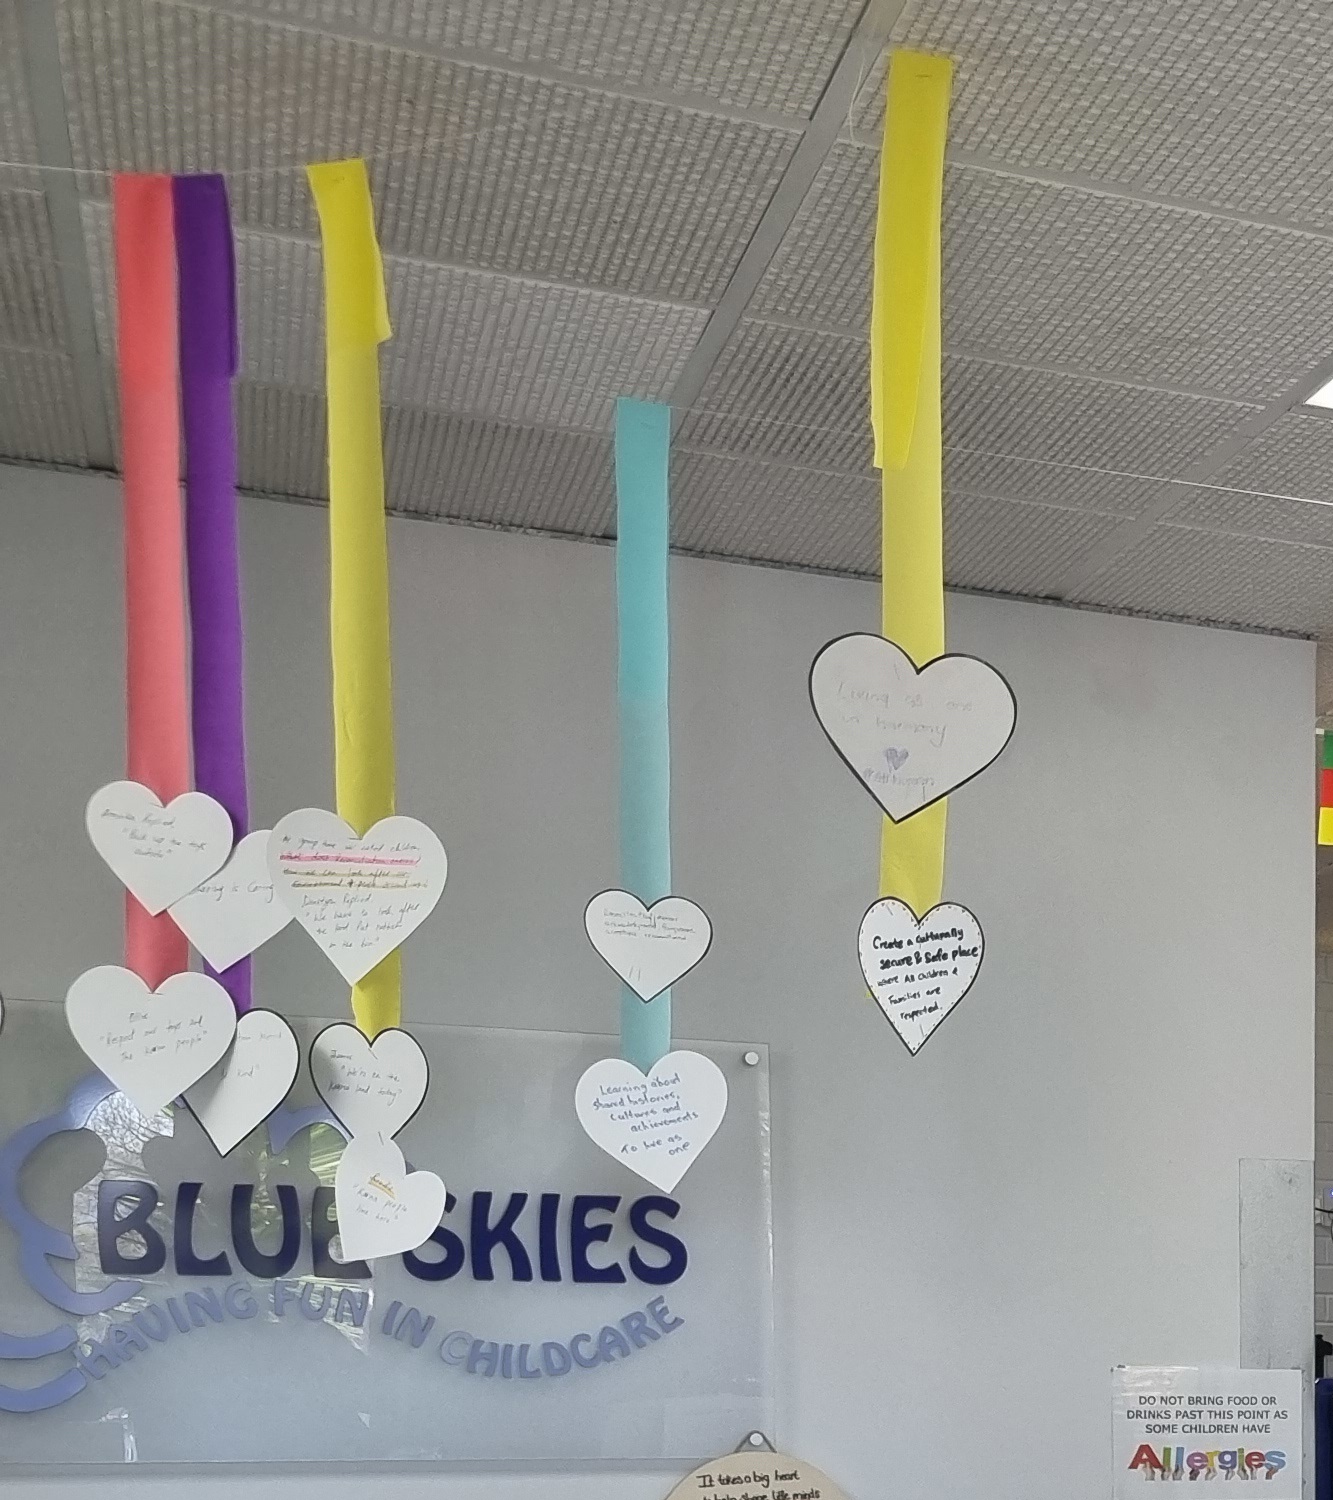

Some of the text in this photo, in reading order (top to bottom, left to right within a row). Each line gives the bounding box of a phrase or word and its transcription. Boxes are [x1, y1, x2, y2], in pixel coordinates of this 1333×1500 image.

[600, 1073, 681, 1096] Learning about
[631, 1111, 699, 1132] achievements
[99, 1180, 688, 1284] BLUE SKIES
[83, 1280, 686, 1379] HAVING FUN IN CHILDCARE
[1139, 1396, 1277, 1405] DO NOT BRING FOOD OR
[1127, 1410, 1288, 1419] DRINKS PAST THIS POINT AS
[1145, 1425, 1270, 1433] SOME CHILDREN HAVE
[1128, 1444, 1286, 1470] Allergies
[697, 1474, 714, 1488] It
[718, 1473, 744, 1485] takes
[753, 1471, 769, 1487] big
[775, 1470, 800, 1481] heart
[793, 1490, 820, 1500] minds
